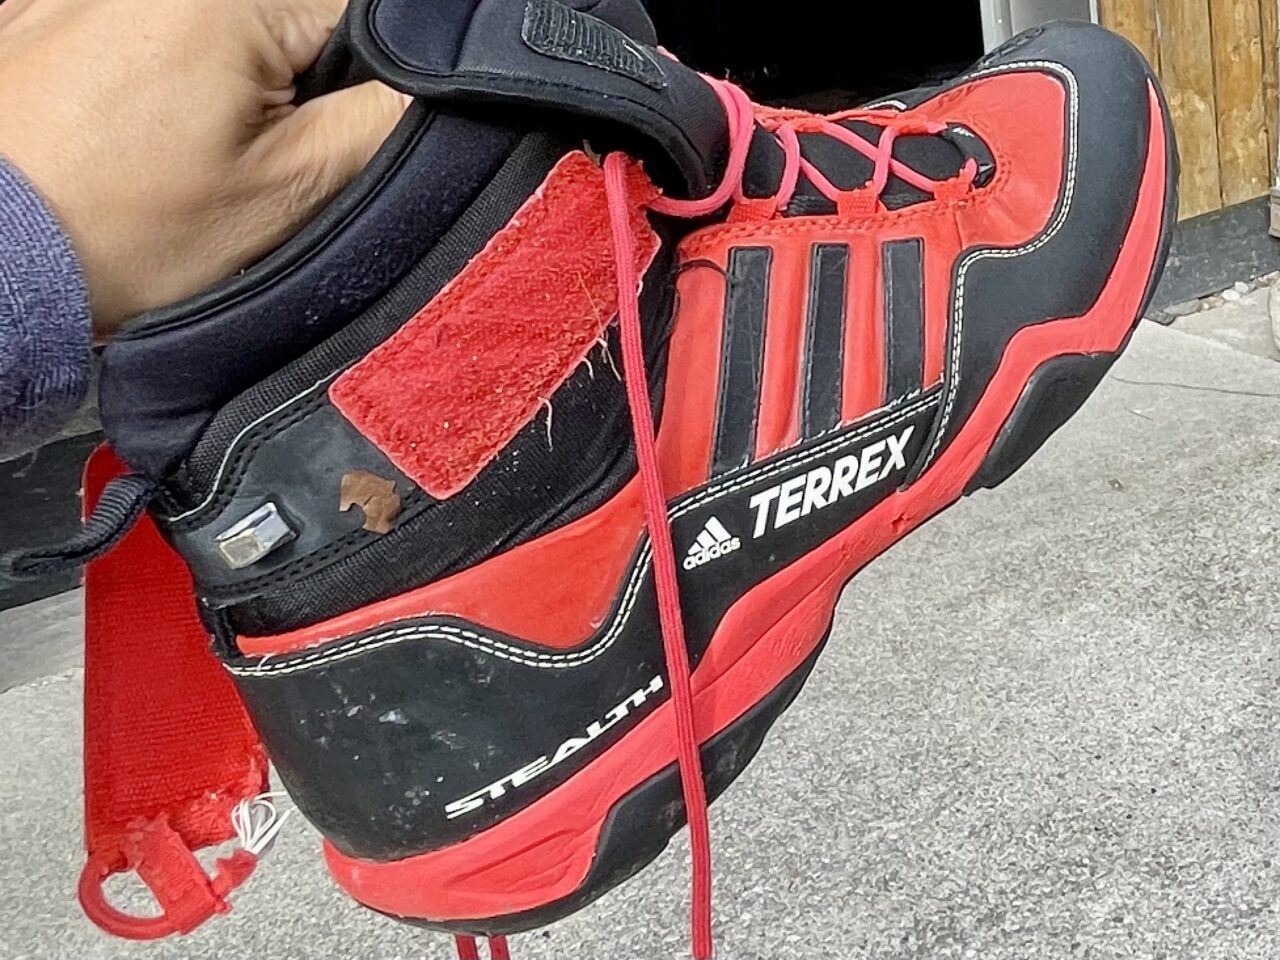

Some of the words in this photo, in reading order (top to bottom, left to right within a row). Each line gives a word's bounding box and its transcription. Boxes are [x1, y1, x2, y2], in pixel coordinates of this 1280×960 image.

[748, 426, 915, 539] TERREX
[682, 536, 741, 571] adidas
[444, 674, 664, 820] STEALTH
